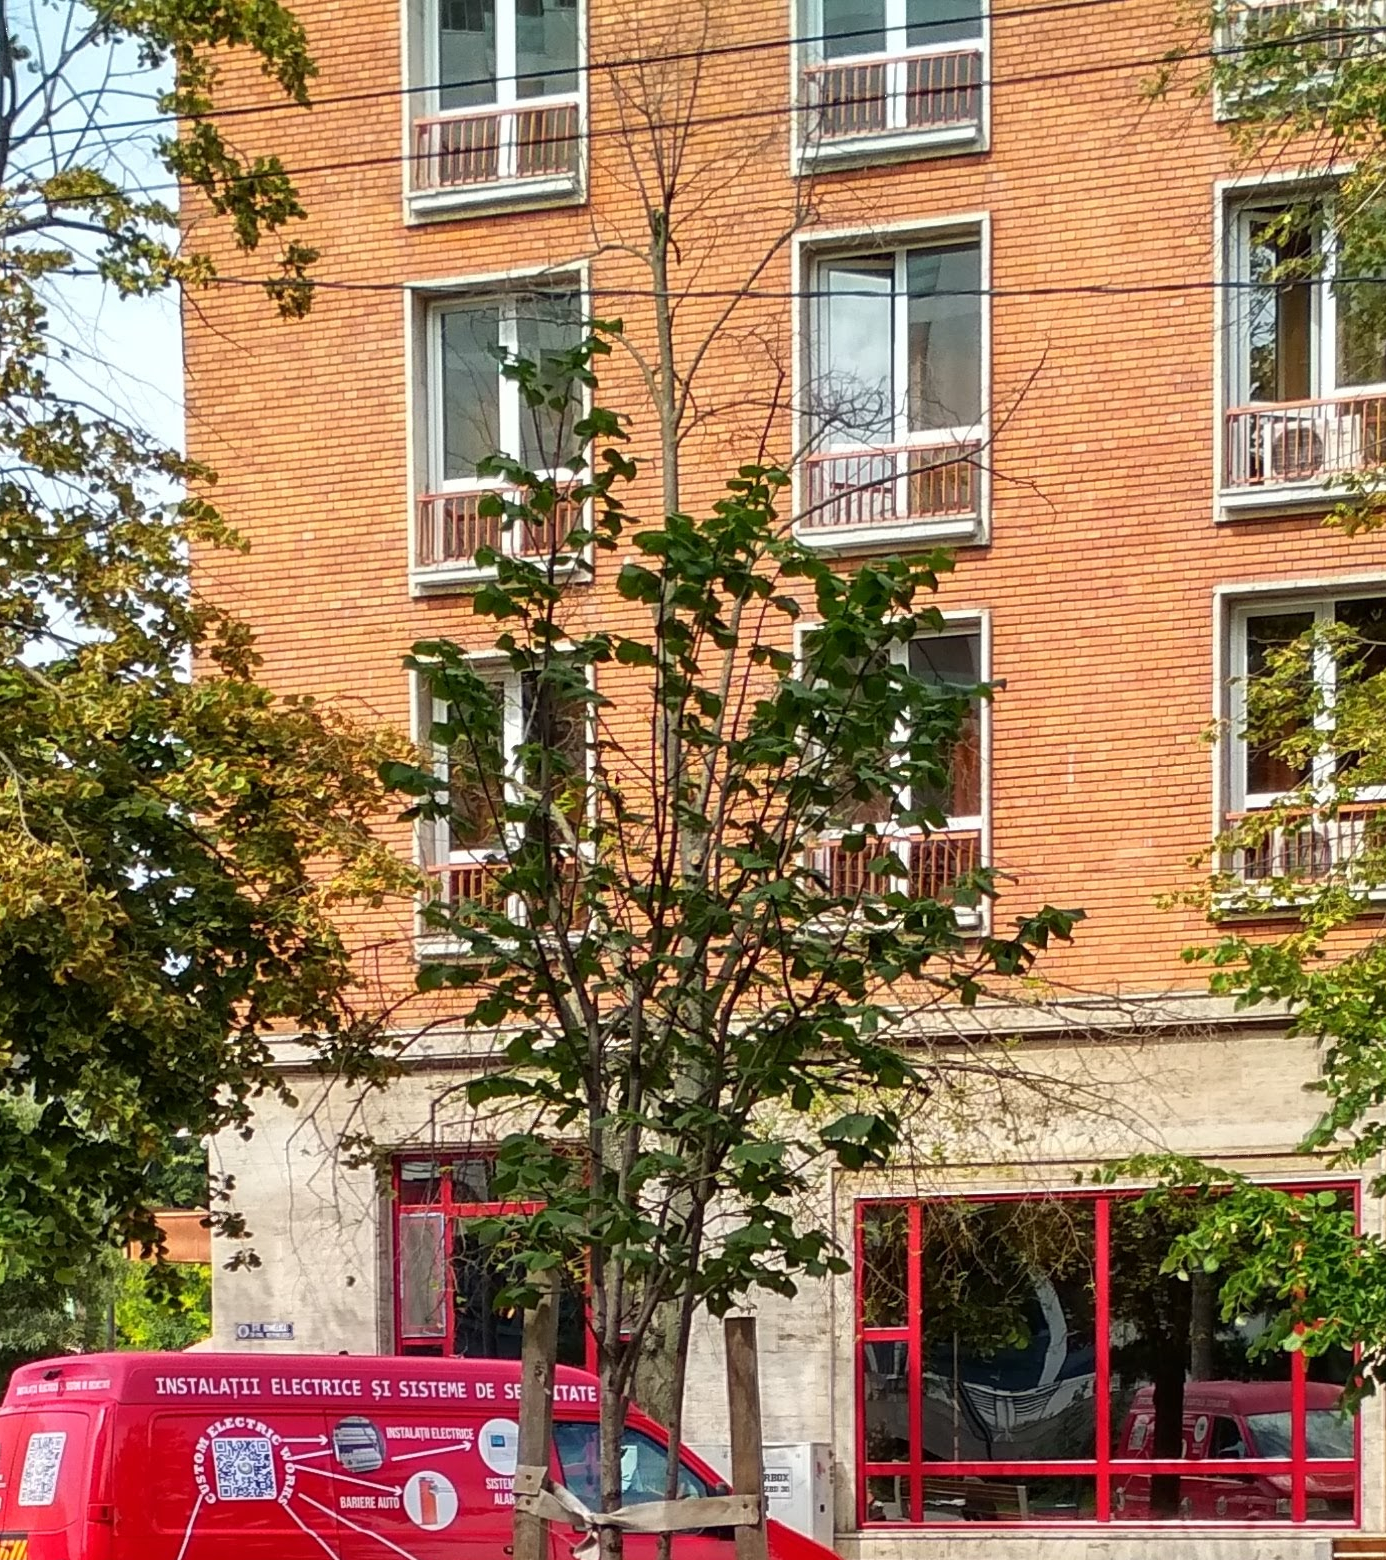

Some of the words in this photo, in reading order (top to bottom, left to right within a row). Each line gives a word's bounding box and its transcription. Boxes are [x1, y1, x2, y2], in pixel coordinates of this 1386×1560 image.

[155, 1377, 261, 1400] INSTALAȚII
[271, 1379, 362, 1397] ELECTRICE
[371, 1380, 392, 1402] ȘI
[399, 1381, 467, 1399] SISTEME
[476, 1383, 495, 1399] DE
[504, 1383, 598, 1402] SEITATE
[431, 1428, 474, 1440] ELECTRICE
[193, 1437, 217, 1504] CUSTOM
[206, 1417, 282, 1446] ELECTRIC
[277, 1446, 296, 1506] WORKS
[340, 1497, 375, 1510] BARIERE
[377, 1496, 399, 1509] AUTO
